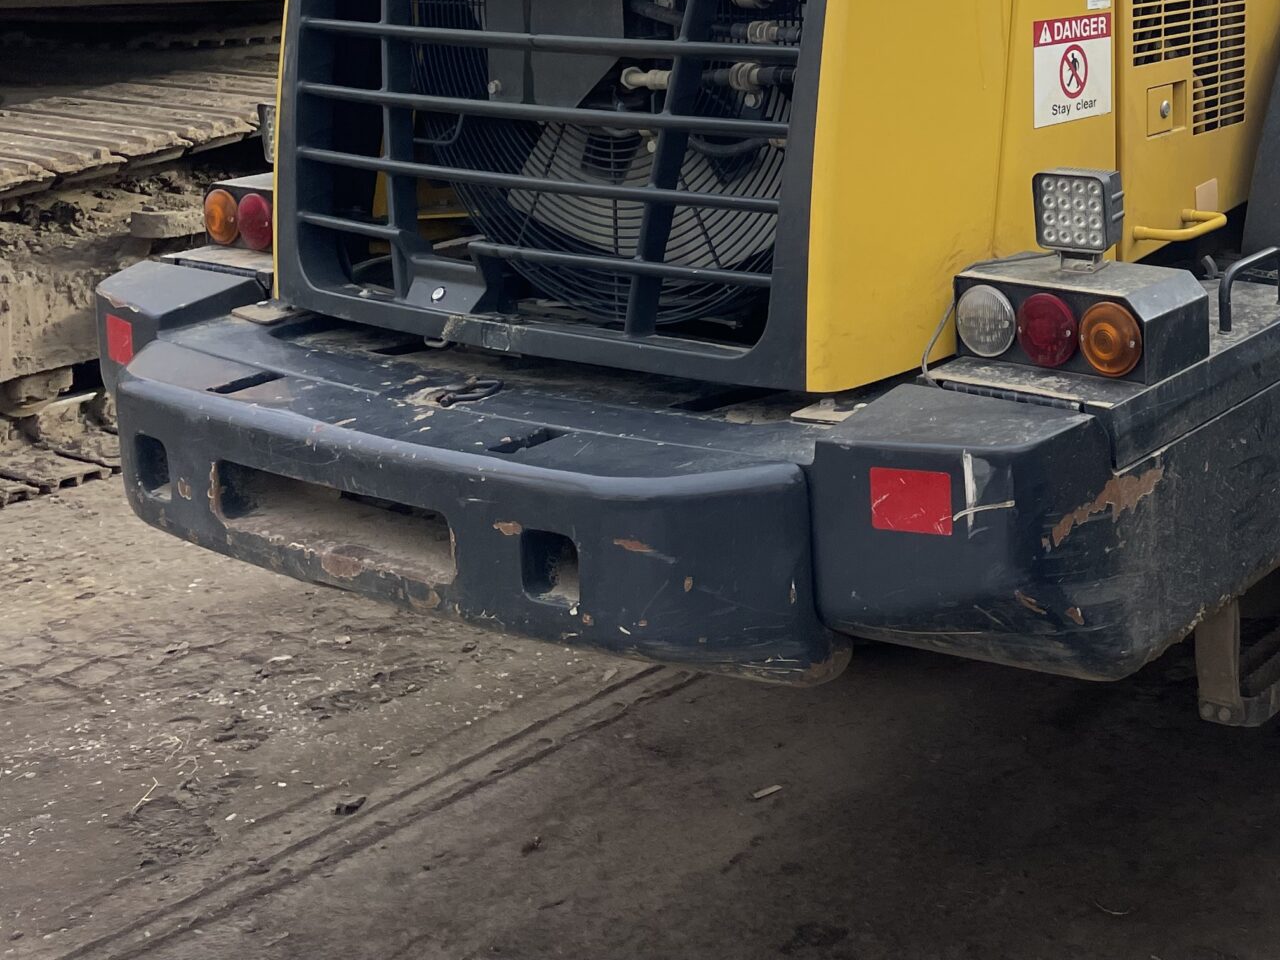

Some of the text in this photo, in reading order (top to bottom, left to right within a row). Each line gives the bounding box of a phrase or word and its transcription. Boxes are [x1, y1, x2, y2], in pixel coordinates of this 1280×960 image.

[1053, 16, 1107, 41] DANGER
[1051, 98, 1097, 117] Stay clear
